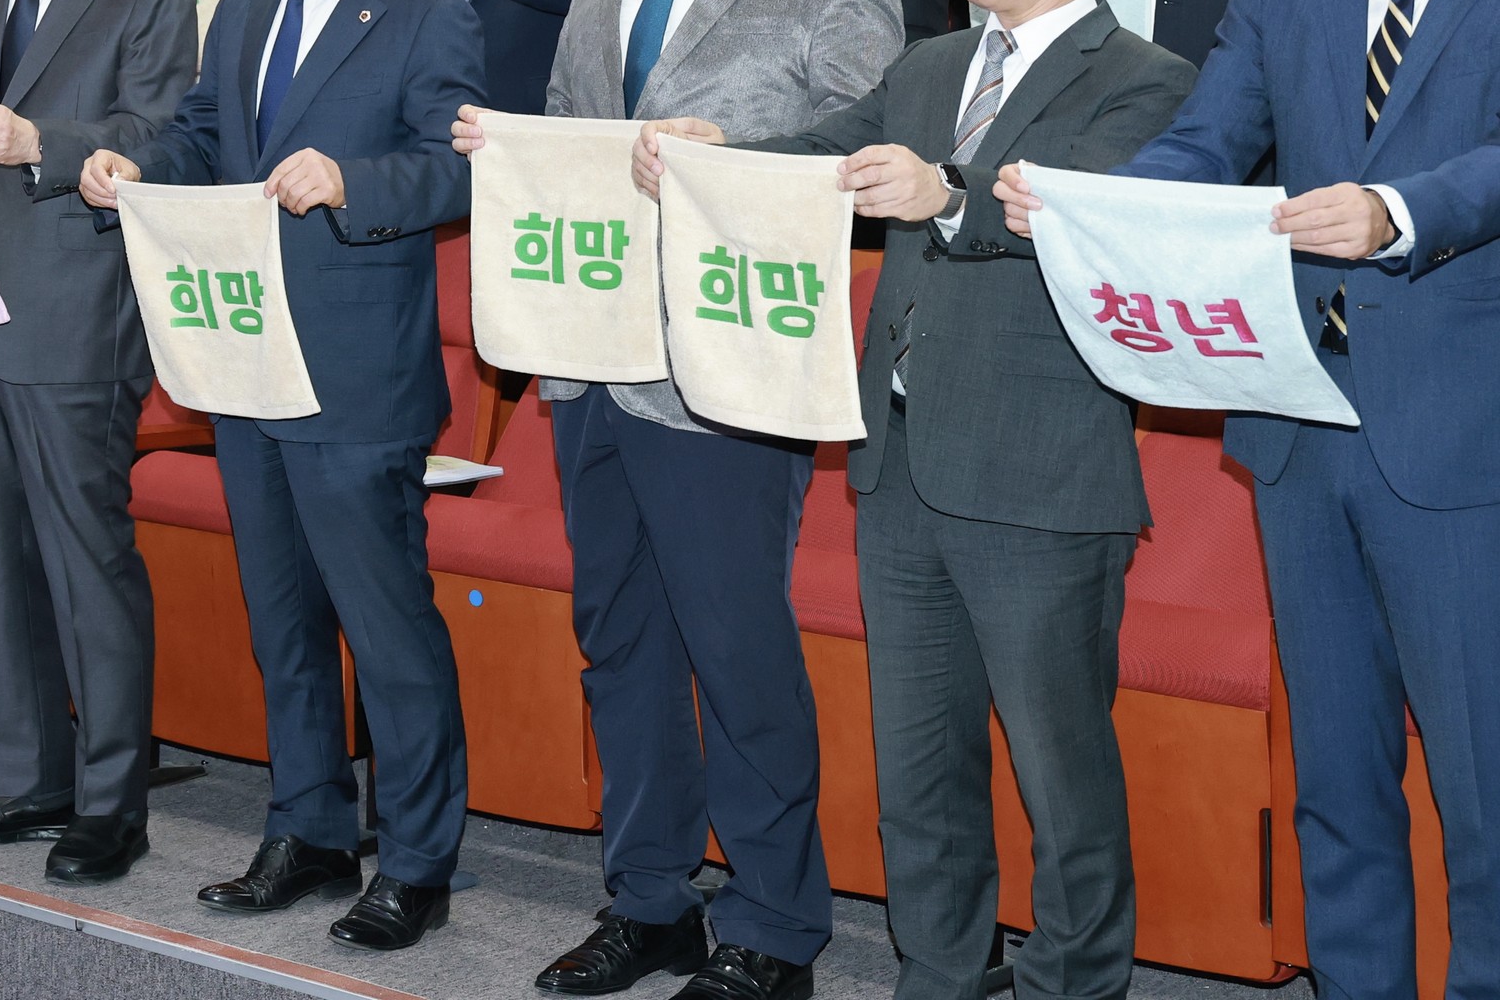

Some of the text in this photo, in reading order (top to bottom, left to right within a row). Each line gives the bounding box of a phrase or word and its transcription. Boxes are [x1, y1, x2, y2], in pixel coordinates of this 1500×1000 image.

[510, 212, 631, 292] 희망
[165, 262, 266, 336] 희망
[694, 244, 826, 340] 희망
[1086, 281, 1266, 360] 청년
